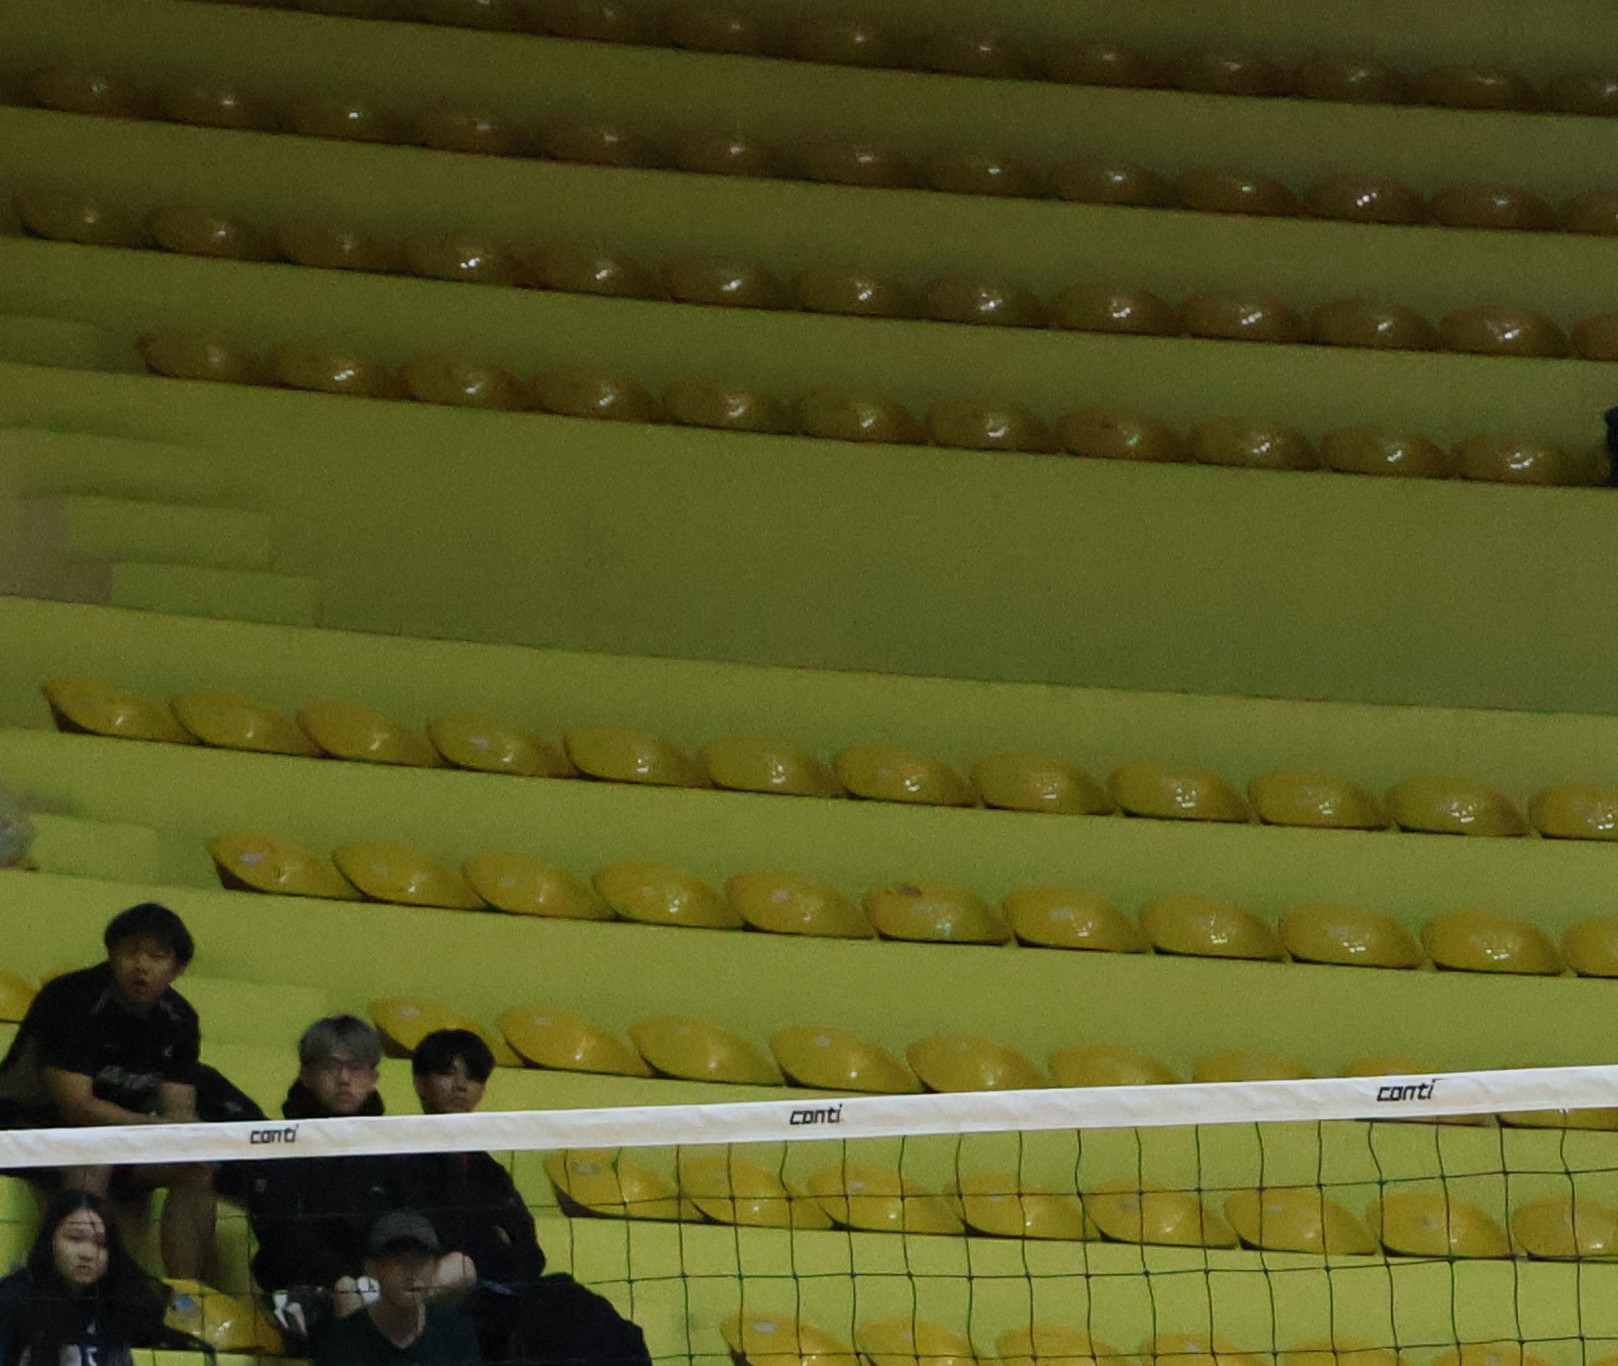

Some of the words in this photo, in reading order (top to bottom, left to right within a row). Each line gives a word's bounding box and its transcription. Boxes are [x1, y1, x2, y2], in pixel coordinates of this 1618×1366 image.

[1375, 1077, 1439, 1103] conti
[789, 1102, 844, 1127] conti
[249, 1124, 300, 1146] conti
